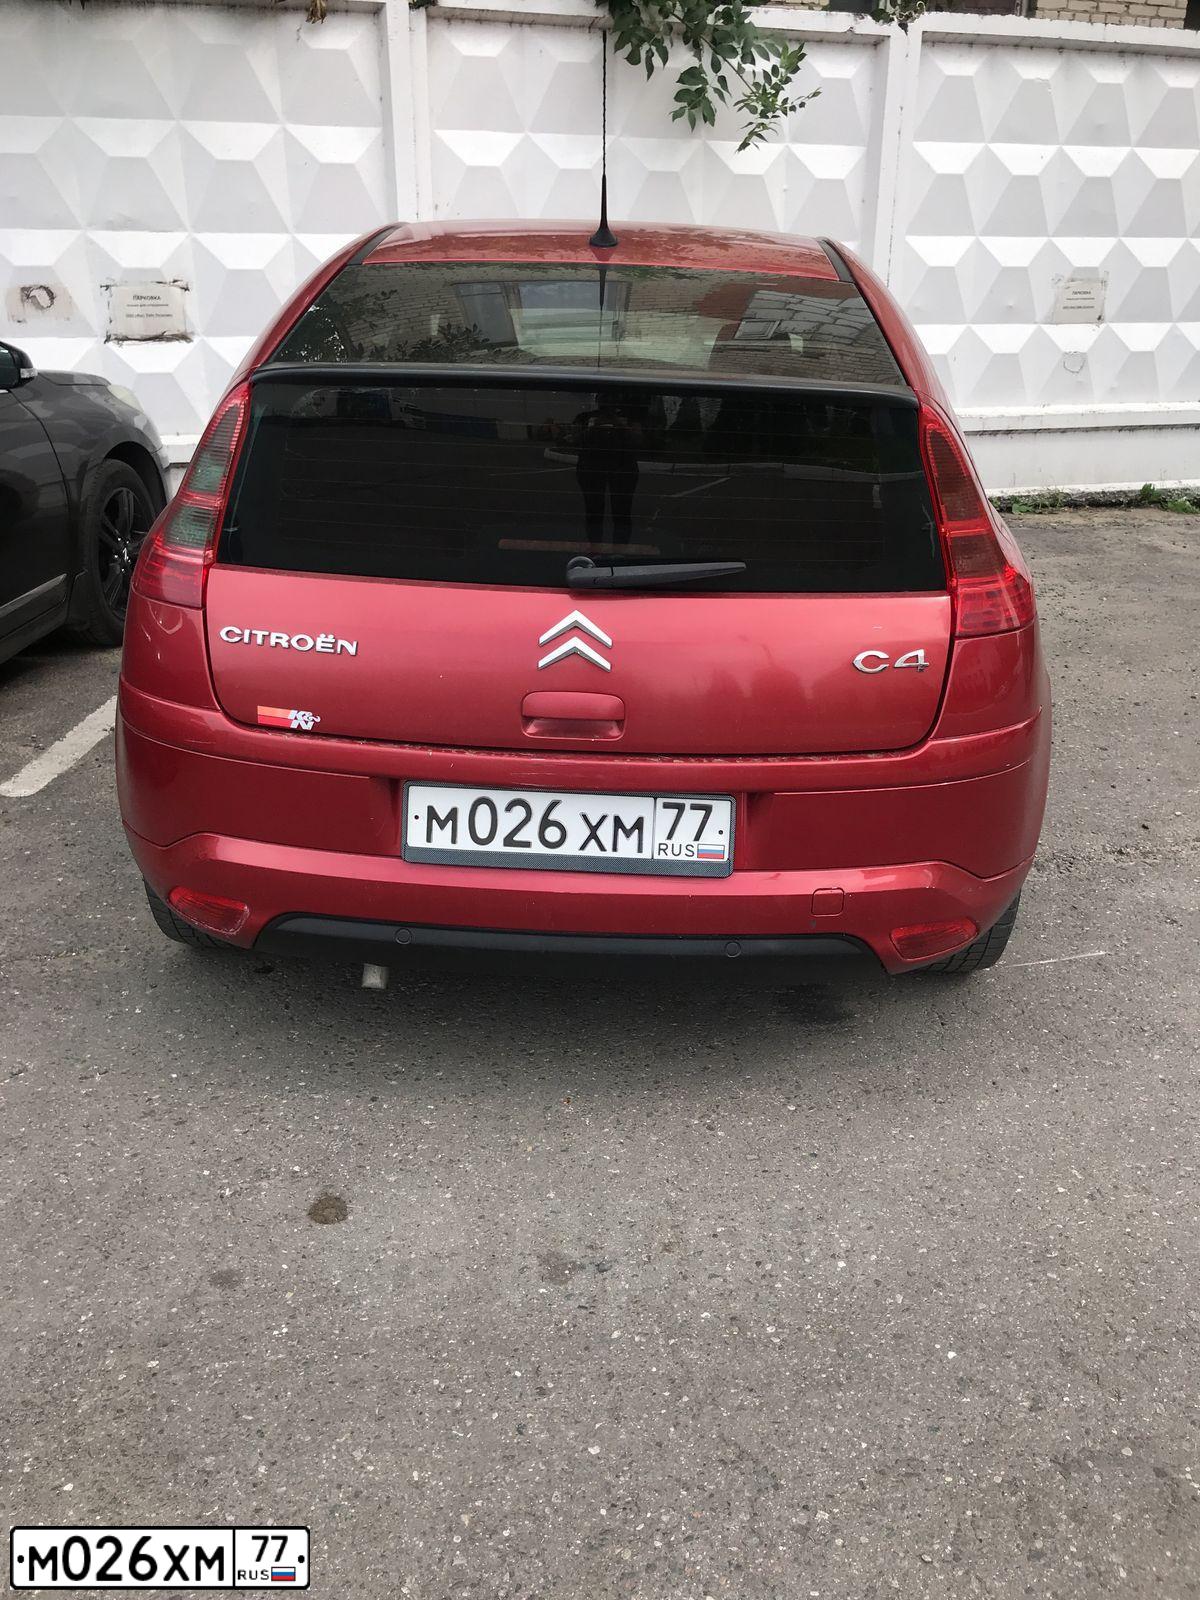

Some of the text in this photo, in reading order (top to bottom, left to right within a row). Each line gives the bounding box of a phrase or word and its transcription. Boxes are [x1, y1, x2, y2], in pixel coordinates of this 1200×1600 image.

[219, 626, 358, 656] CITROËN
[852, 648, 930, 674] C4
[662, 801, 713, 842] 77
[657, 842, 695, 858] RUS
